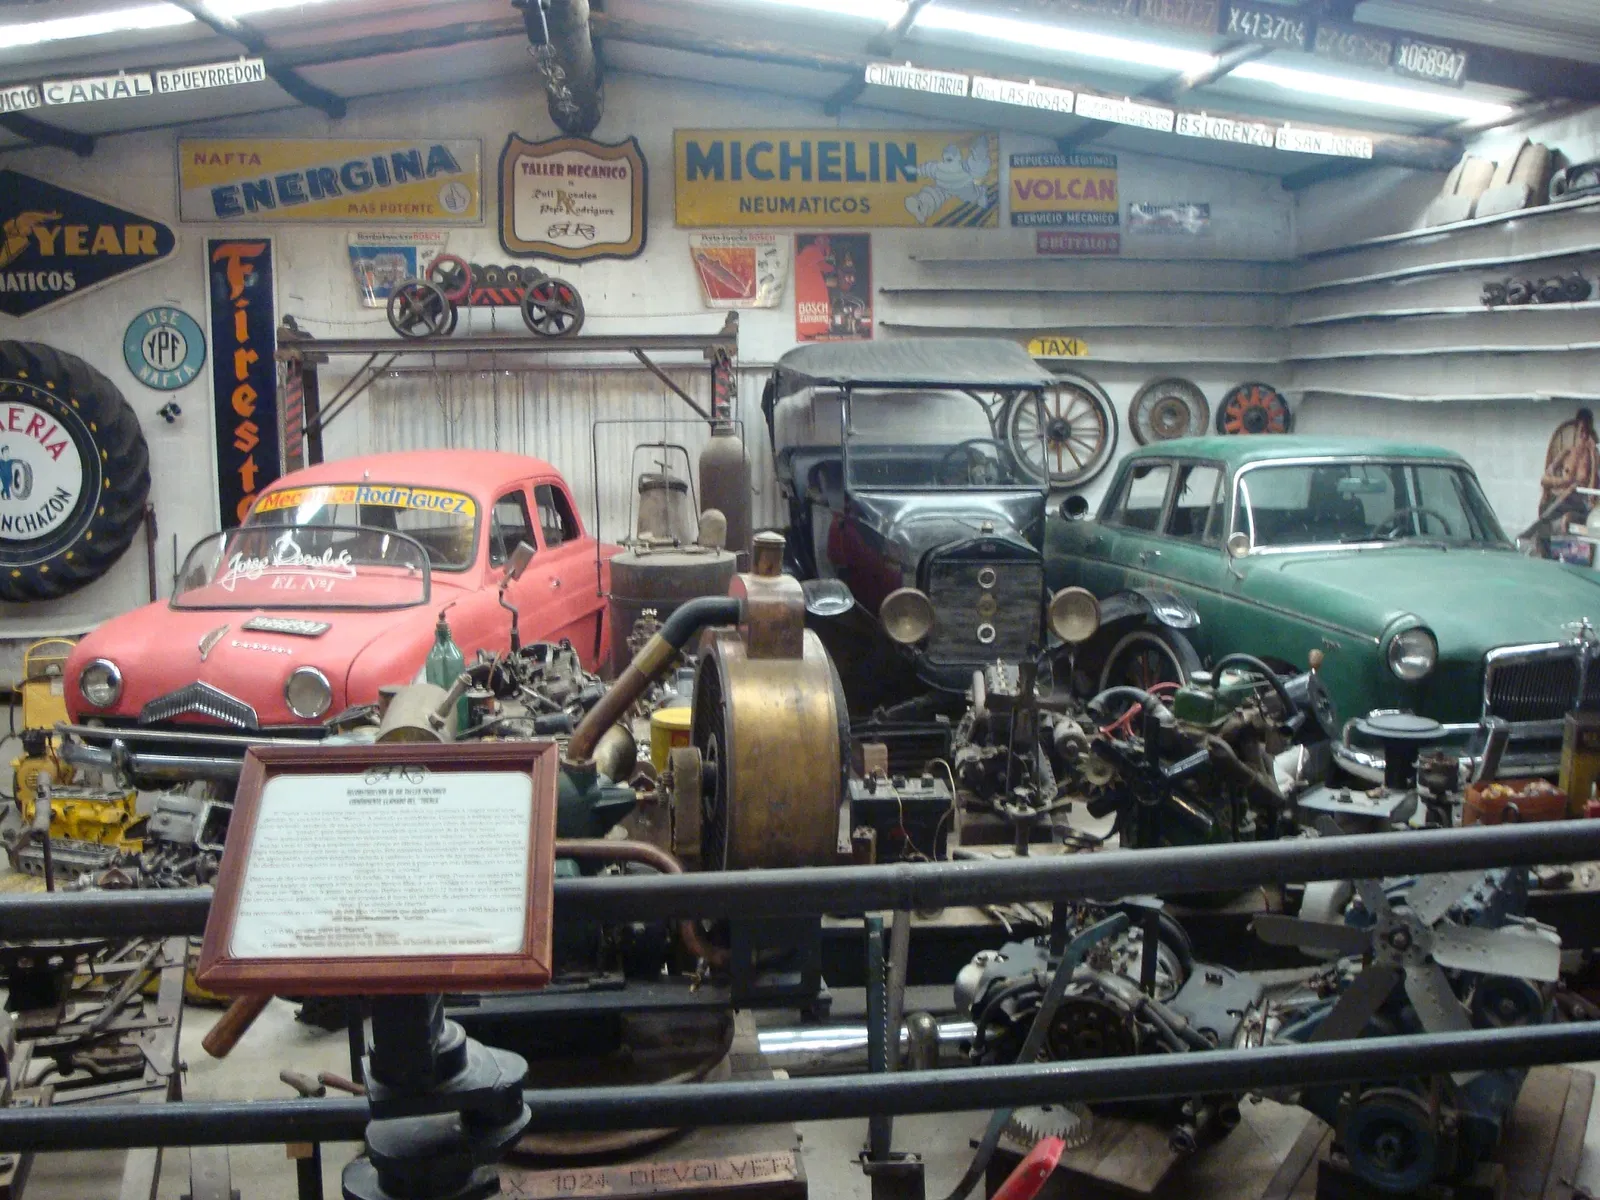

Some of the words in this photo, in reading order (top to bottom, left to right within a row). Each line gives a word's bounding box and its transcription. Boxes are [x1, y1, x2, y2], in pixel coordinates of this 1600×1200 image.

[1398, 43, 1467, 82] X068947
[47, 78, 152, 106] CANAL
[193, 152, 262, 166] NAFTA
[685, 140, 918, 184] MICHELIN
[210, 144, 462, 219] ENERGINA
[521, 162, 564, 177] TALLER
[566, 163, 627, 180] MECANICO
[1014, 179, 1116, 201] VOLCAN
[739, 196, 872, 215] NEUMATICOS
[1017, 213, 1063, 225] SERVICIO
[1066, 213, 1115, 225] MECANICO
[31, 225, 158, 256] YEAR
[146, 310, 179, 326] USE
[148, 331, 180, 366] YPF
[1040, 340, 1078, 355] TAXI
[140, 364, 195, 387] NAFTA
[628, 1155, 793, 1187] DEVOLVER
